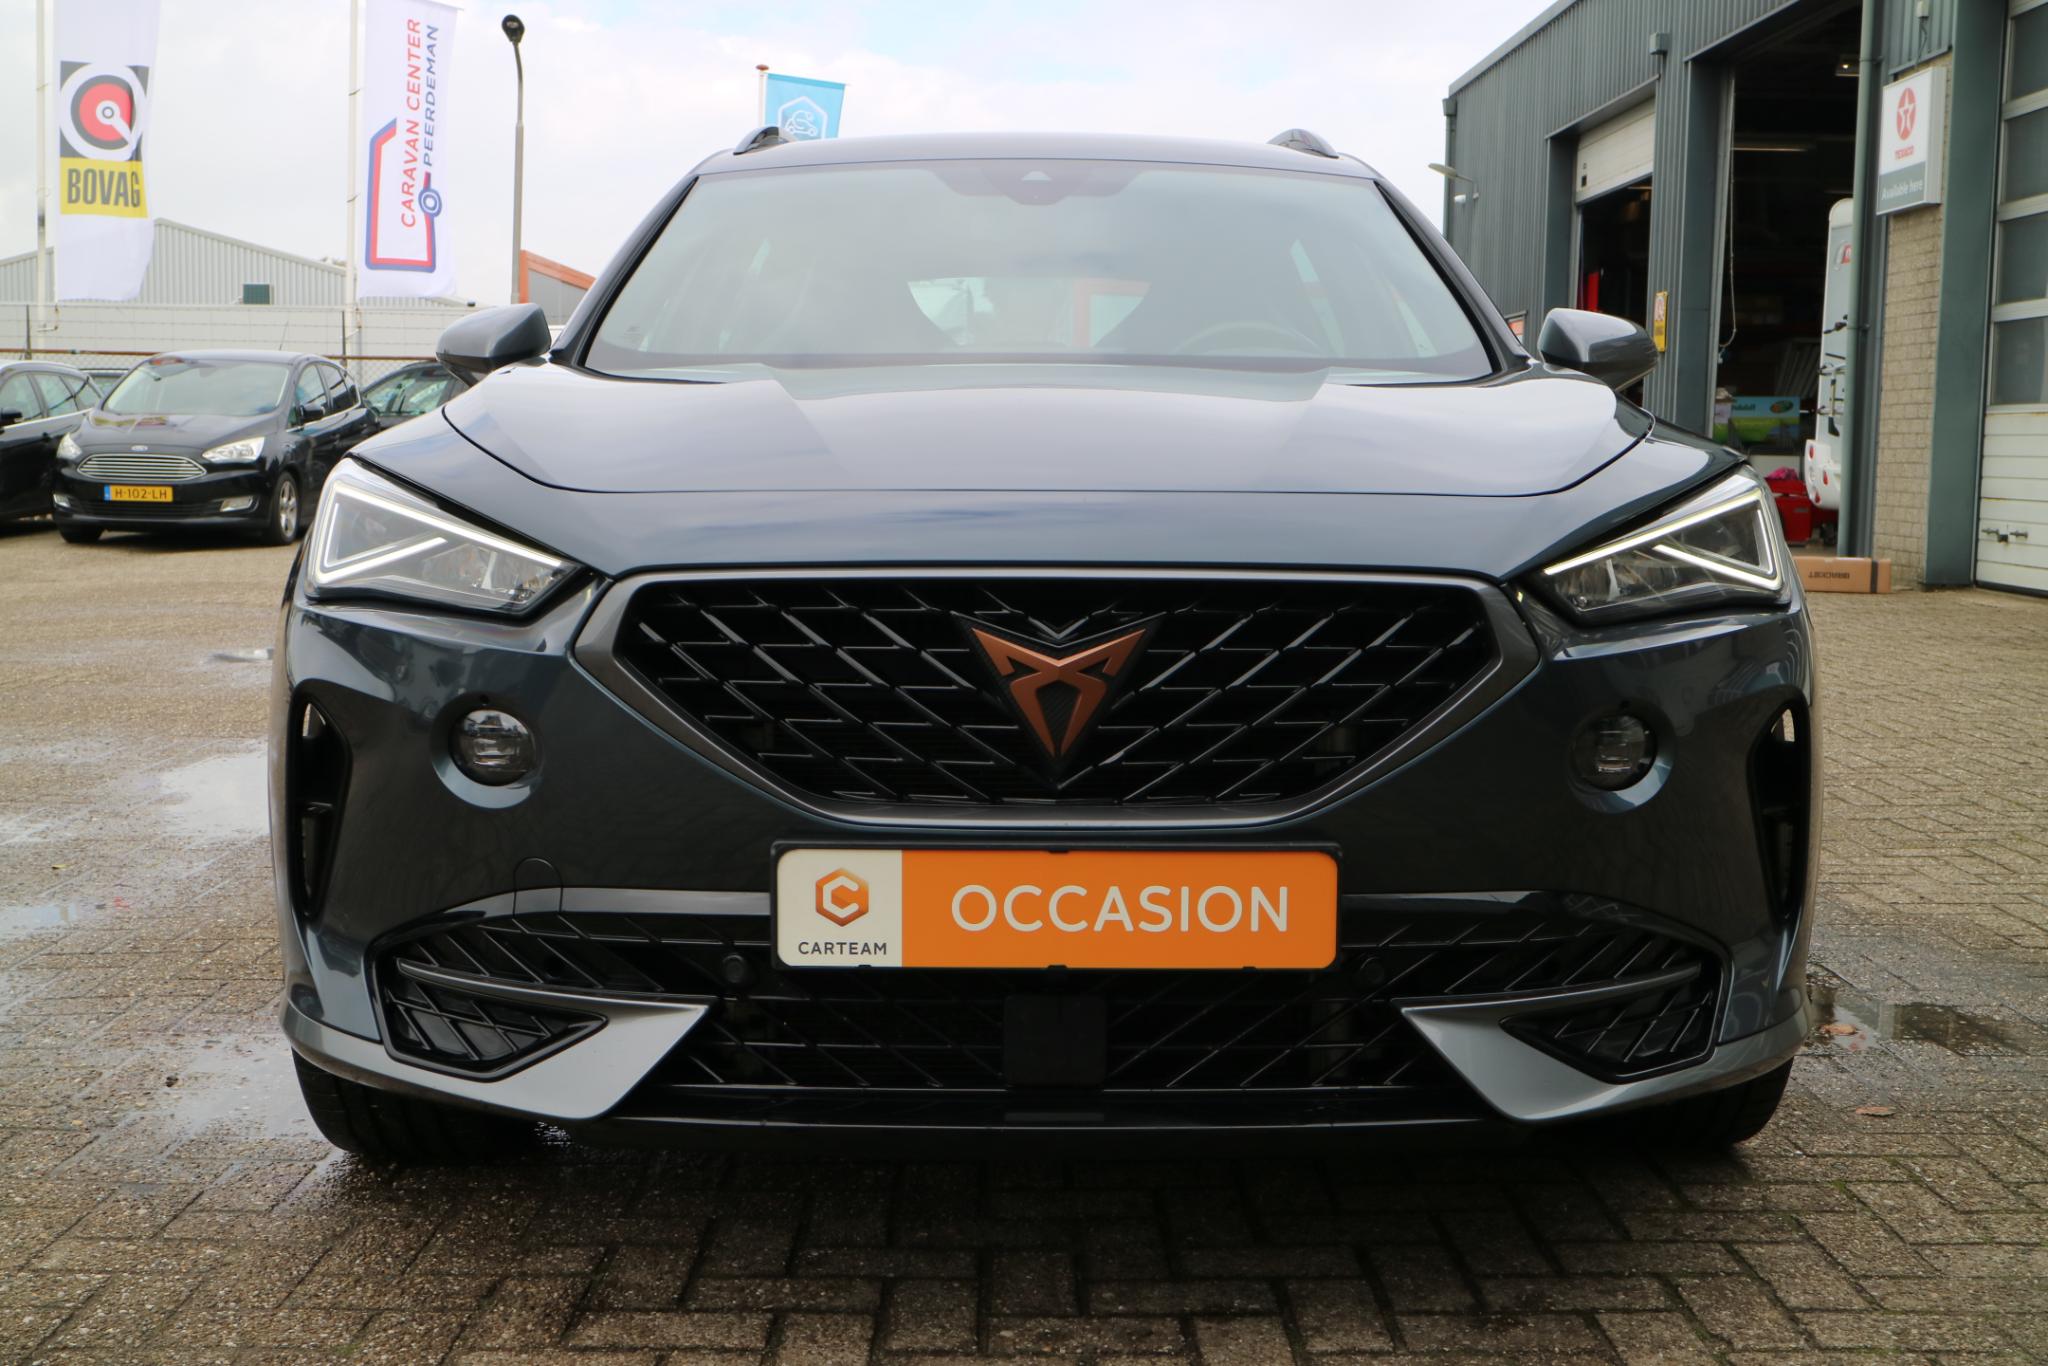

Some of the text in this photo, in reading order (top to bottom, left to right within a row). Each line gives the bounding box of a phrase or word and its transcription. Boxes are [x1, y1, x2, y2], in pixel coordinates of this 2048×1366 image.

[423, 25, 438, 167] PEERDEMAN
[401, 19, 421, 228] CARAVAN CENTER
[67, 168, 141, 208] BOVAG
[1909, 178, 1923, 194] here
[951, 884, 1288, 932] OCCASION
[798, 942, 888, 955] CARTEAM
